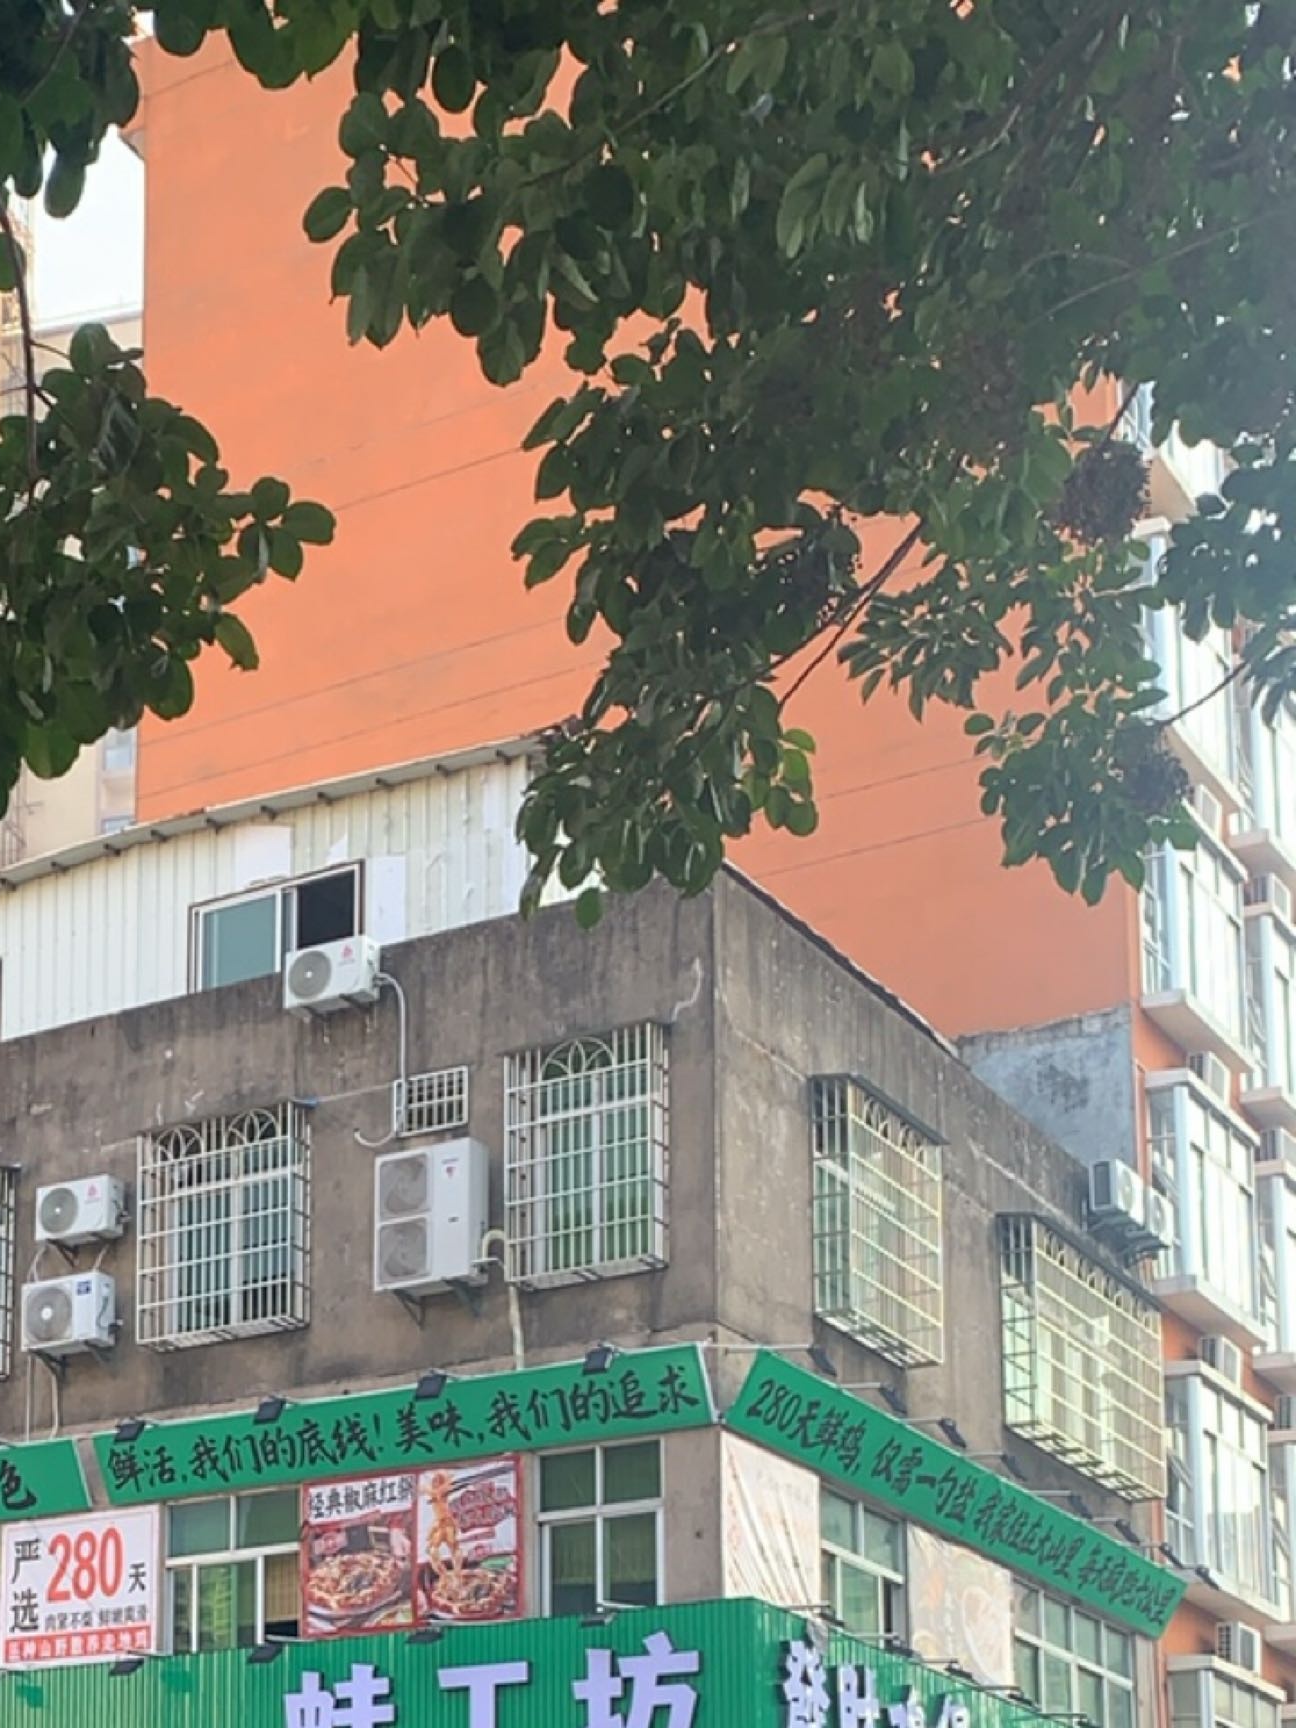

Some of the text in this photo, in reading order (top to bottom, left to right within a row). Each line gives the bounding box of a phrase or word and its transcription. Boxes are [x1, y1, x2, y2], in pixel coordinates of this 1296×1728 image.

[9, 1538, 41, 1633] 严选
[46, 1527, 147, 1604] 280 天
